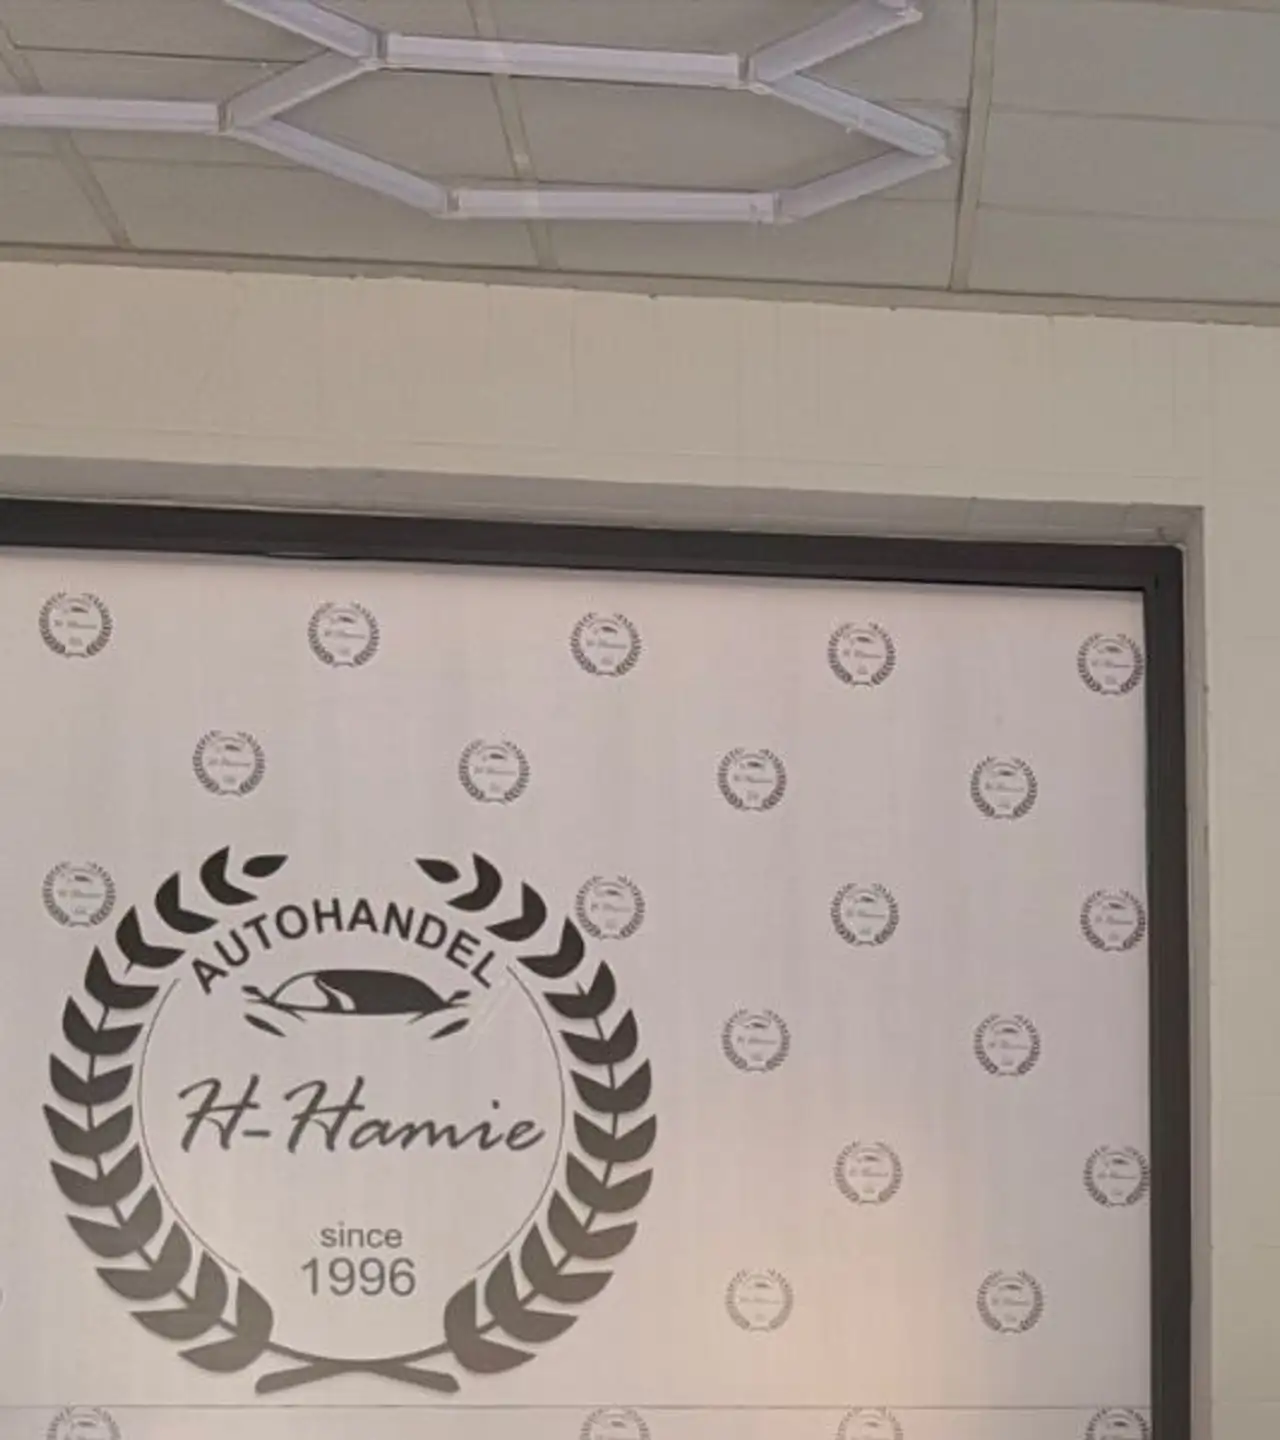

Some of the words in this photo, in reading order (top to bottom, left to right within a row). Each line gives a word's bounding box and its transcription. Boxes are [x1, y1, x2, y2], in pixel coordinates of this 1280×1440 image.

[191, 897, 497, 995] AUTOHANDEL
[178, 1073, 546, 1154] H-Hamie
[319, 1220, 403, 1249] since
[301, 1256, 417, 1297] 1996
